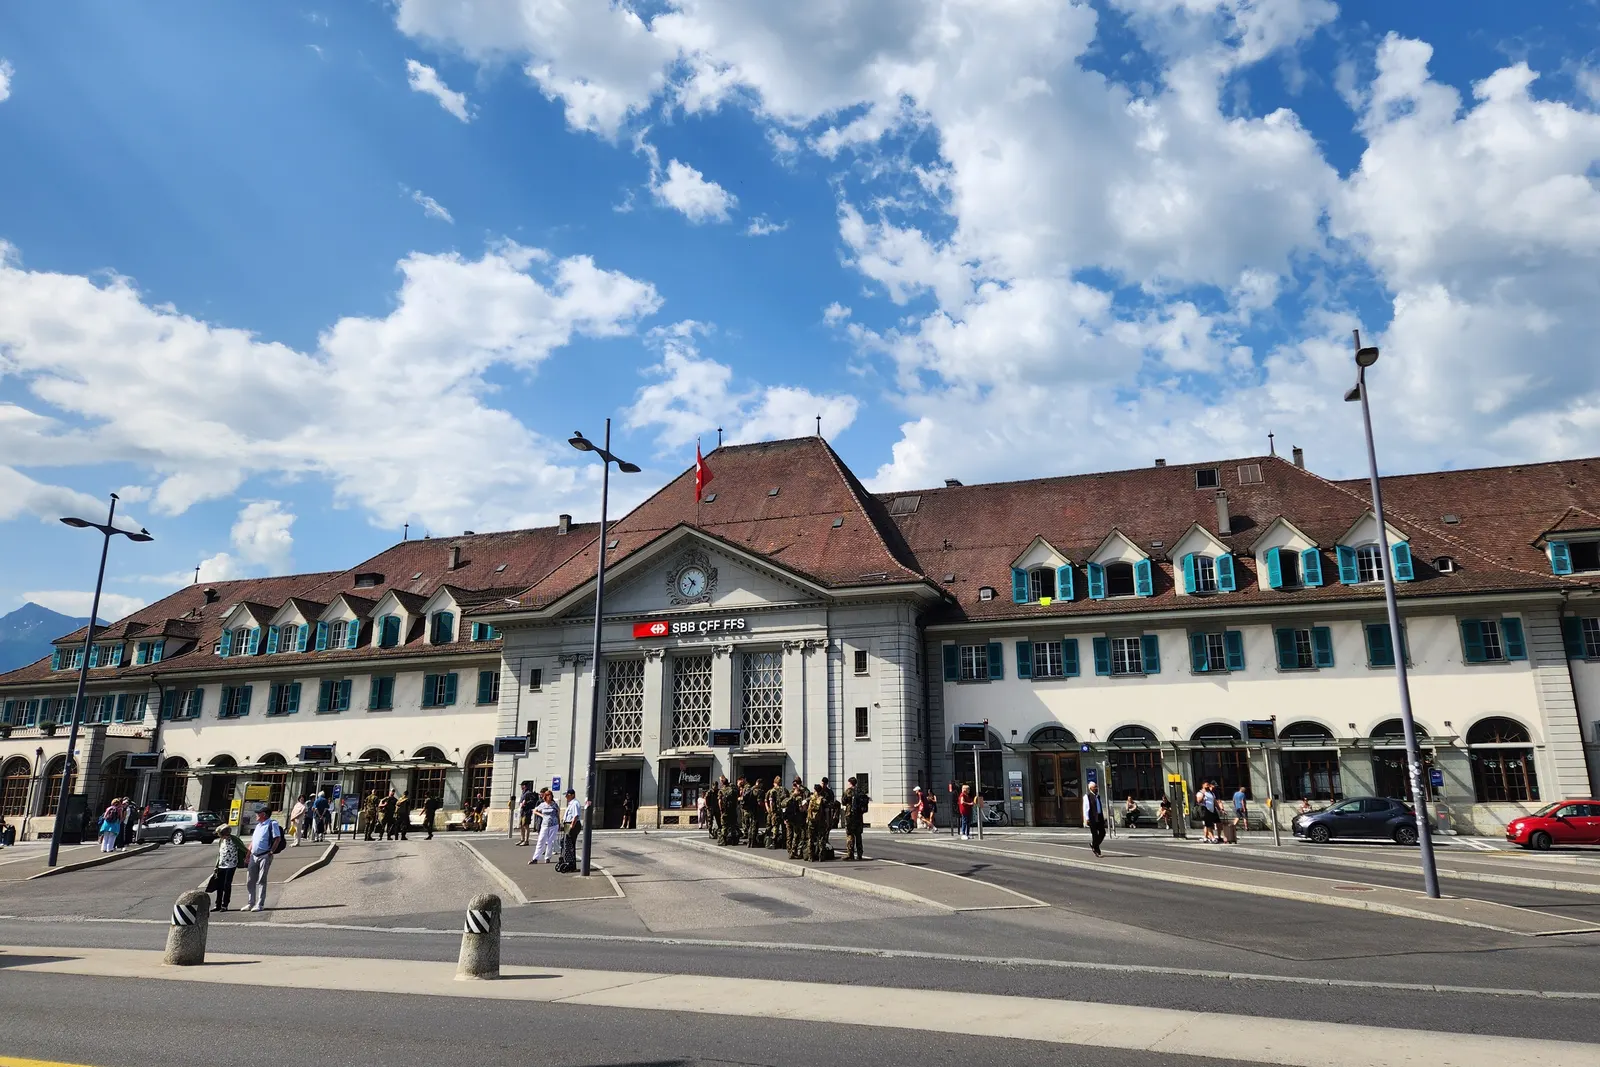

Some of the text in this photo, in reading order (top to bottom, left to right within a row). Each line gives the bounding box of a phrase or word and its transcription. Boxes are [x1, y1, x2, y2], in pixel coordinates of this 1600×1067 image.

[672, 618, 744, 633] SBB CFF FFS
